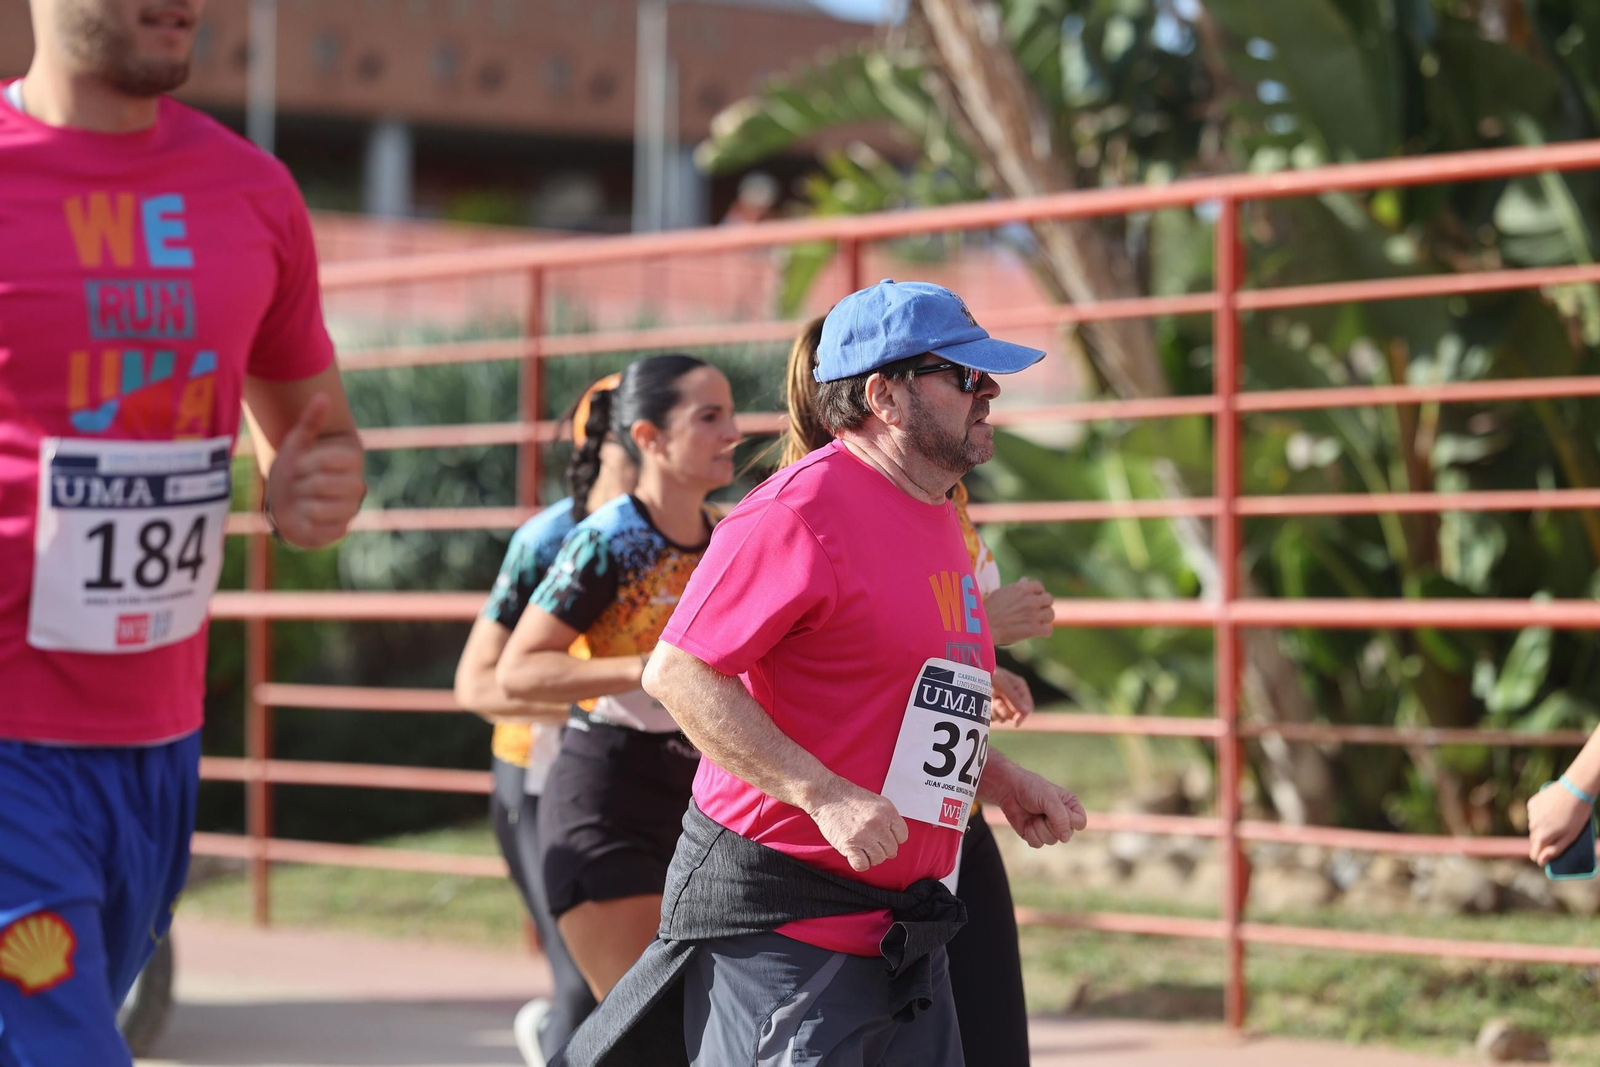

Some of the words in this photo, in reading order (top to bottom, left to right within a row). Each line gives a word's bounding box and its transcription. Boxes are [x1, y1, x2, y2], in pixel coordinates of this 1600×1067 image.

[63, 191, 194, 269] WE
[94, 281, 190, 337] RUN
[69, 350, 217, 433] UMA
[55, 474, 154, 507] UMA
[84, 513, 207, 589] 184
[928, 570, 981, 634] WE
[922, 683, 977, 717] UMA
[922, 721, 989, 788] 329
[924, 779, 941, 788] JUAN
[941, 783, 956, 792] JOSE
[943, 803, 962, 820] WE
